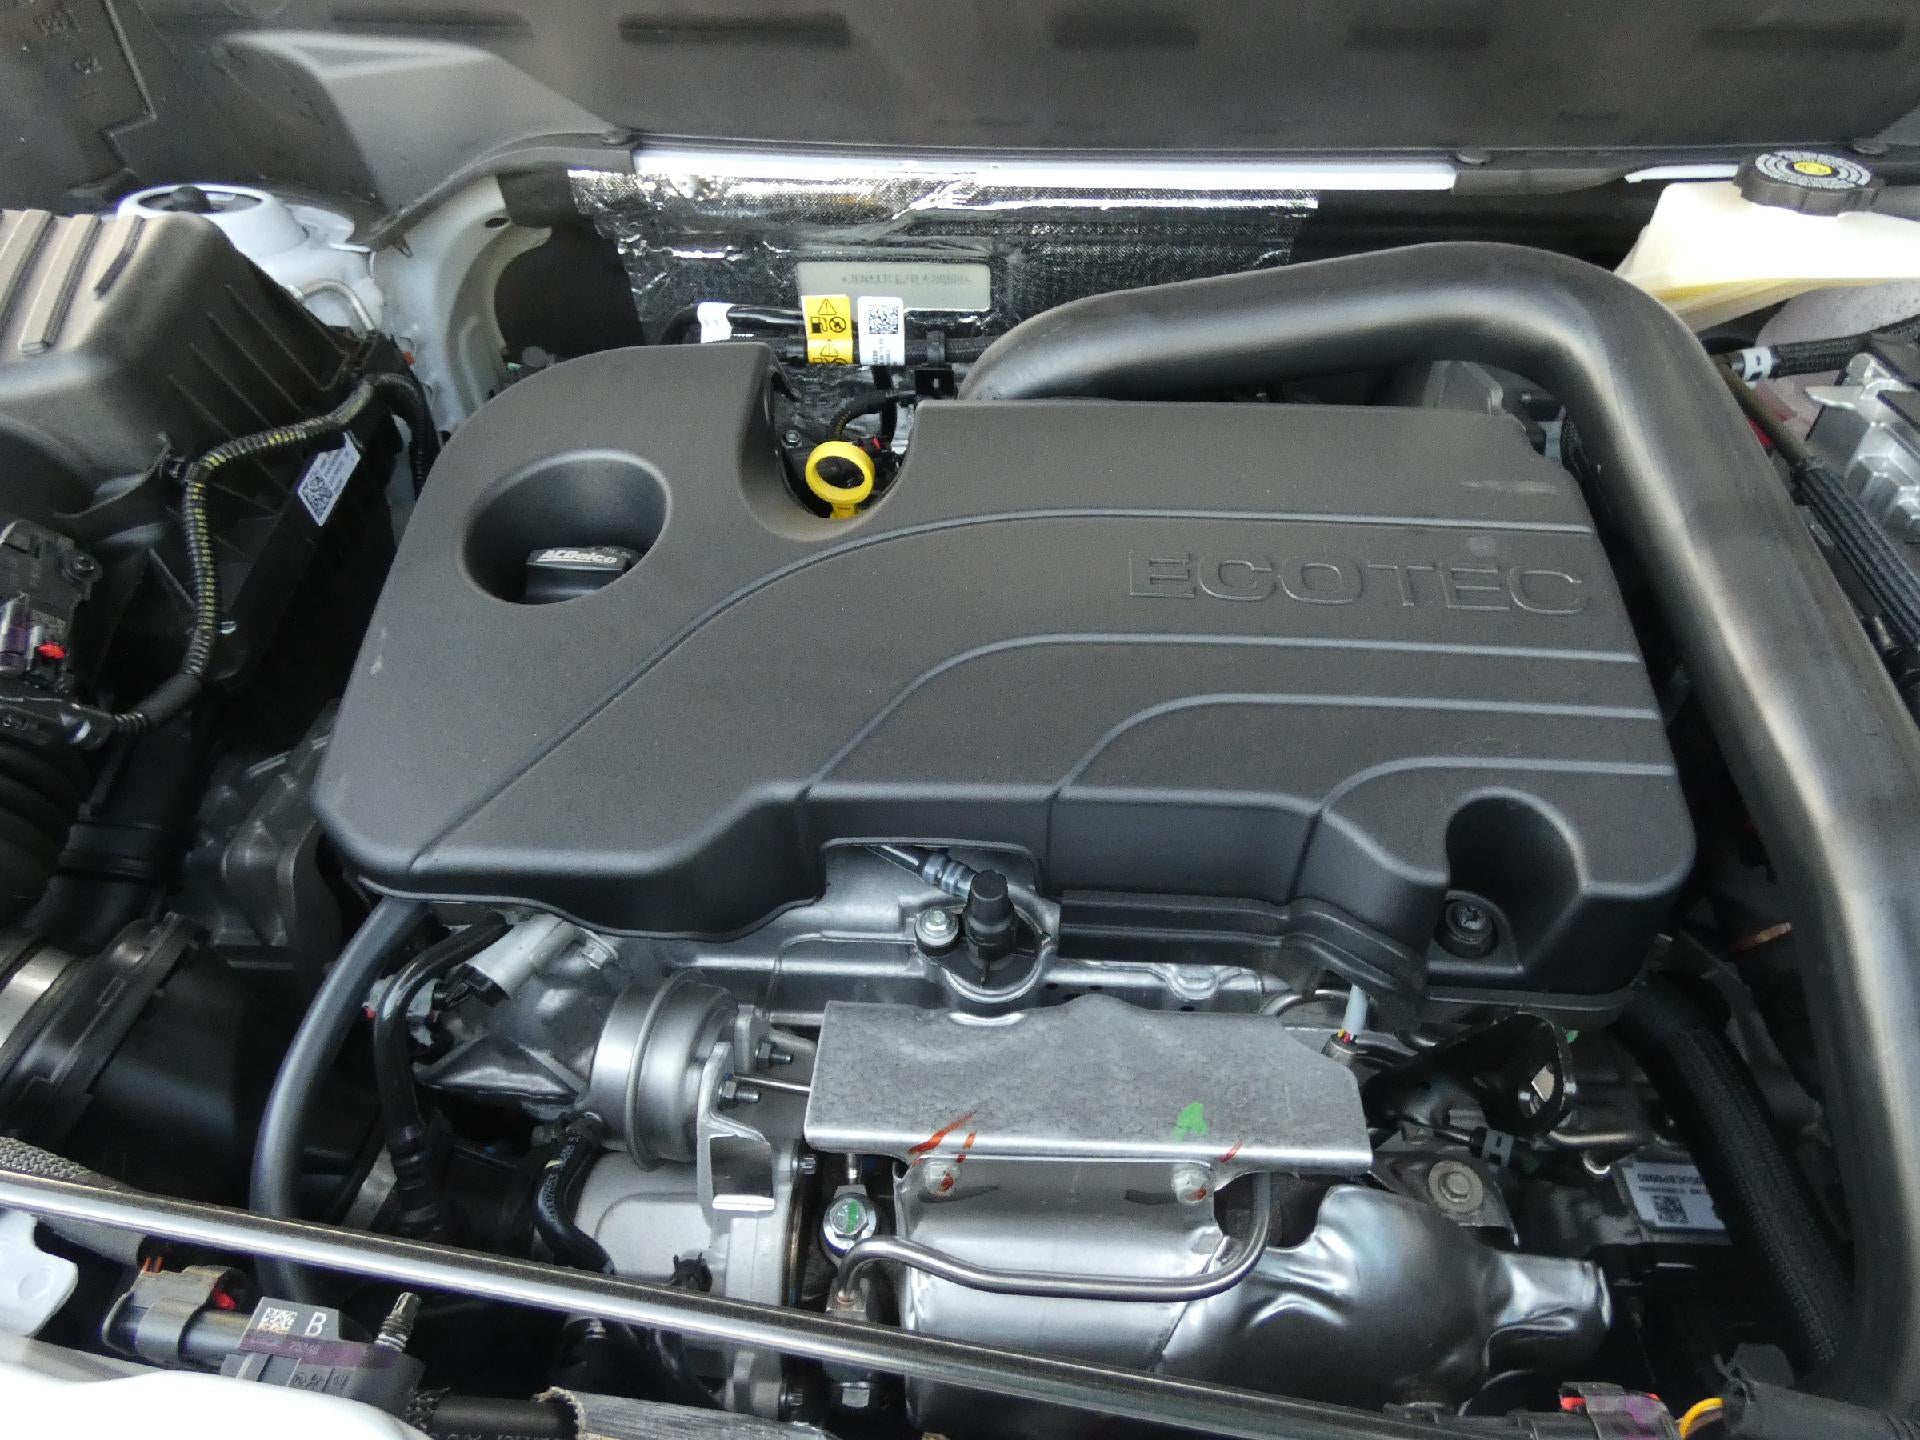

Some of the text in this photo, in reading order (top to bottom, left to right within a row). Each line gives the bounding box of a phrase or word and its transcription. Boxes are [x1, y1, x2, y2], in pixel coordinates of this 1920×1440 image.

[536, 549, 618, 563] ACDelco
[1128, 549, 1588, 616] ECOTEC
[304, 1311, 328, 1337] B
